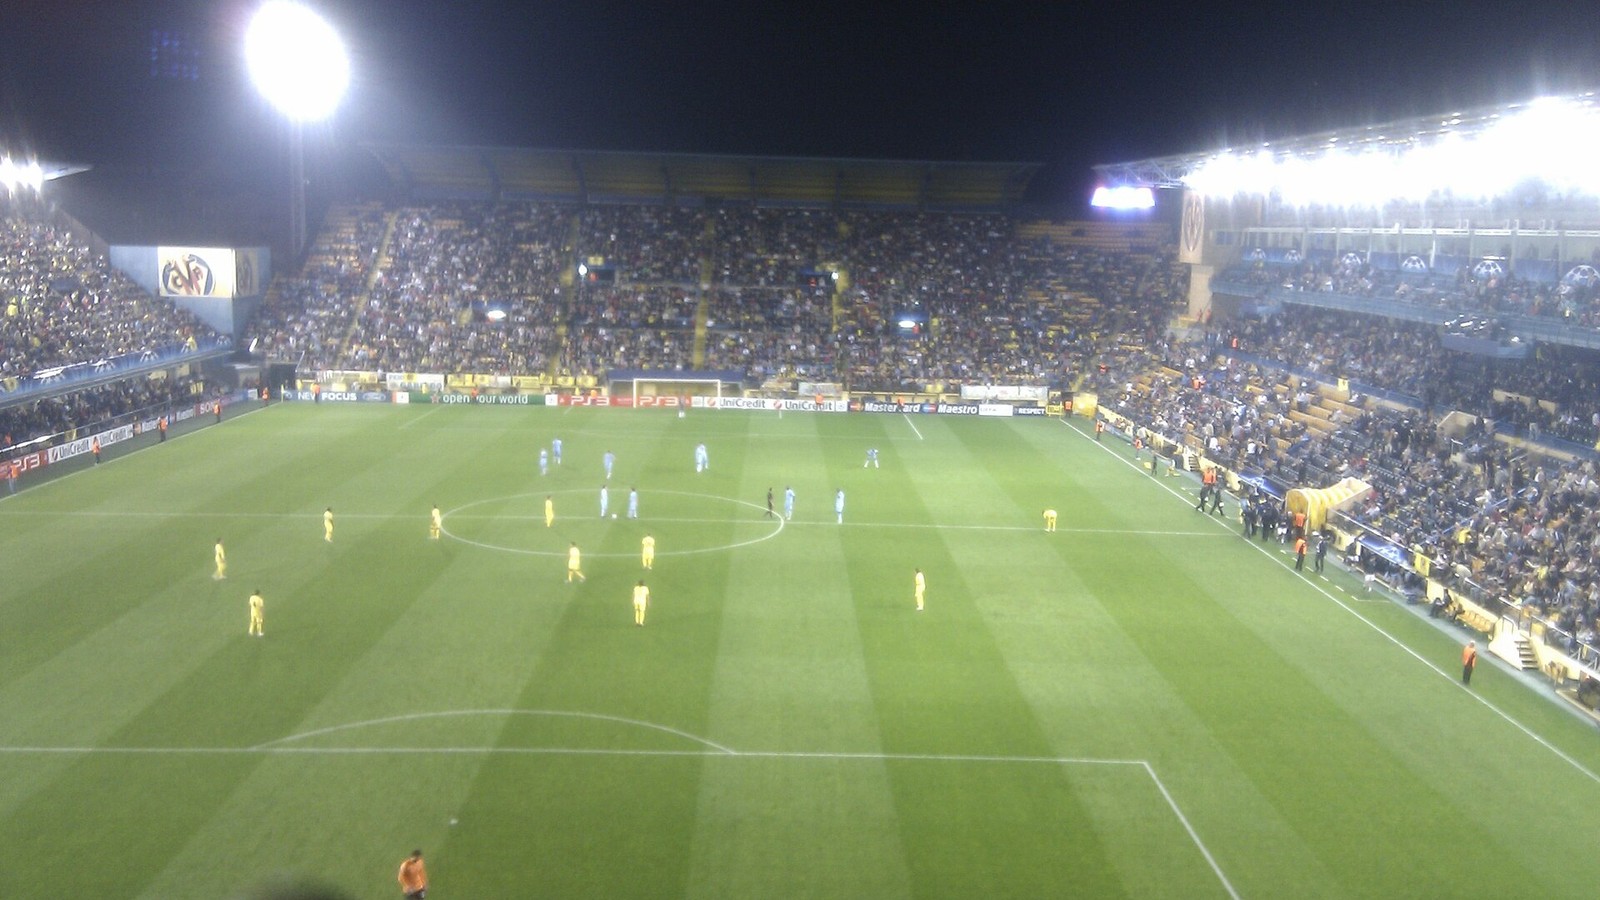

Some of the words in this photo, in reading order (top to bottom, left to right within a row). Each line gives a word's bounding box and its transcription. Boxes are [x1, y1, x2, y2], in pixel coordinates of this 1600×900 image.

[321, 392, 357, 401] FOCUS
[443, 395, 470, 404] open
[499, 394, 529, 404] world
[571, 396, 609, 406] PS3
[640, 396, 678, 407] PS3
[720, 399, 766, 408] UniCredit
[865, 402, 921, 413] Masterard
[938, 404, 978, 414] Maestro
[1018, 407, 1045, 416] RESPECT
[60, 440, 90, 459] UniCredit
